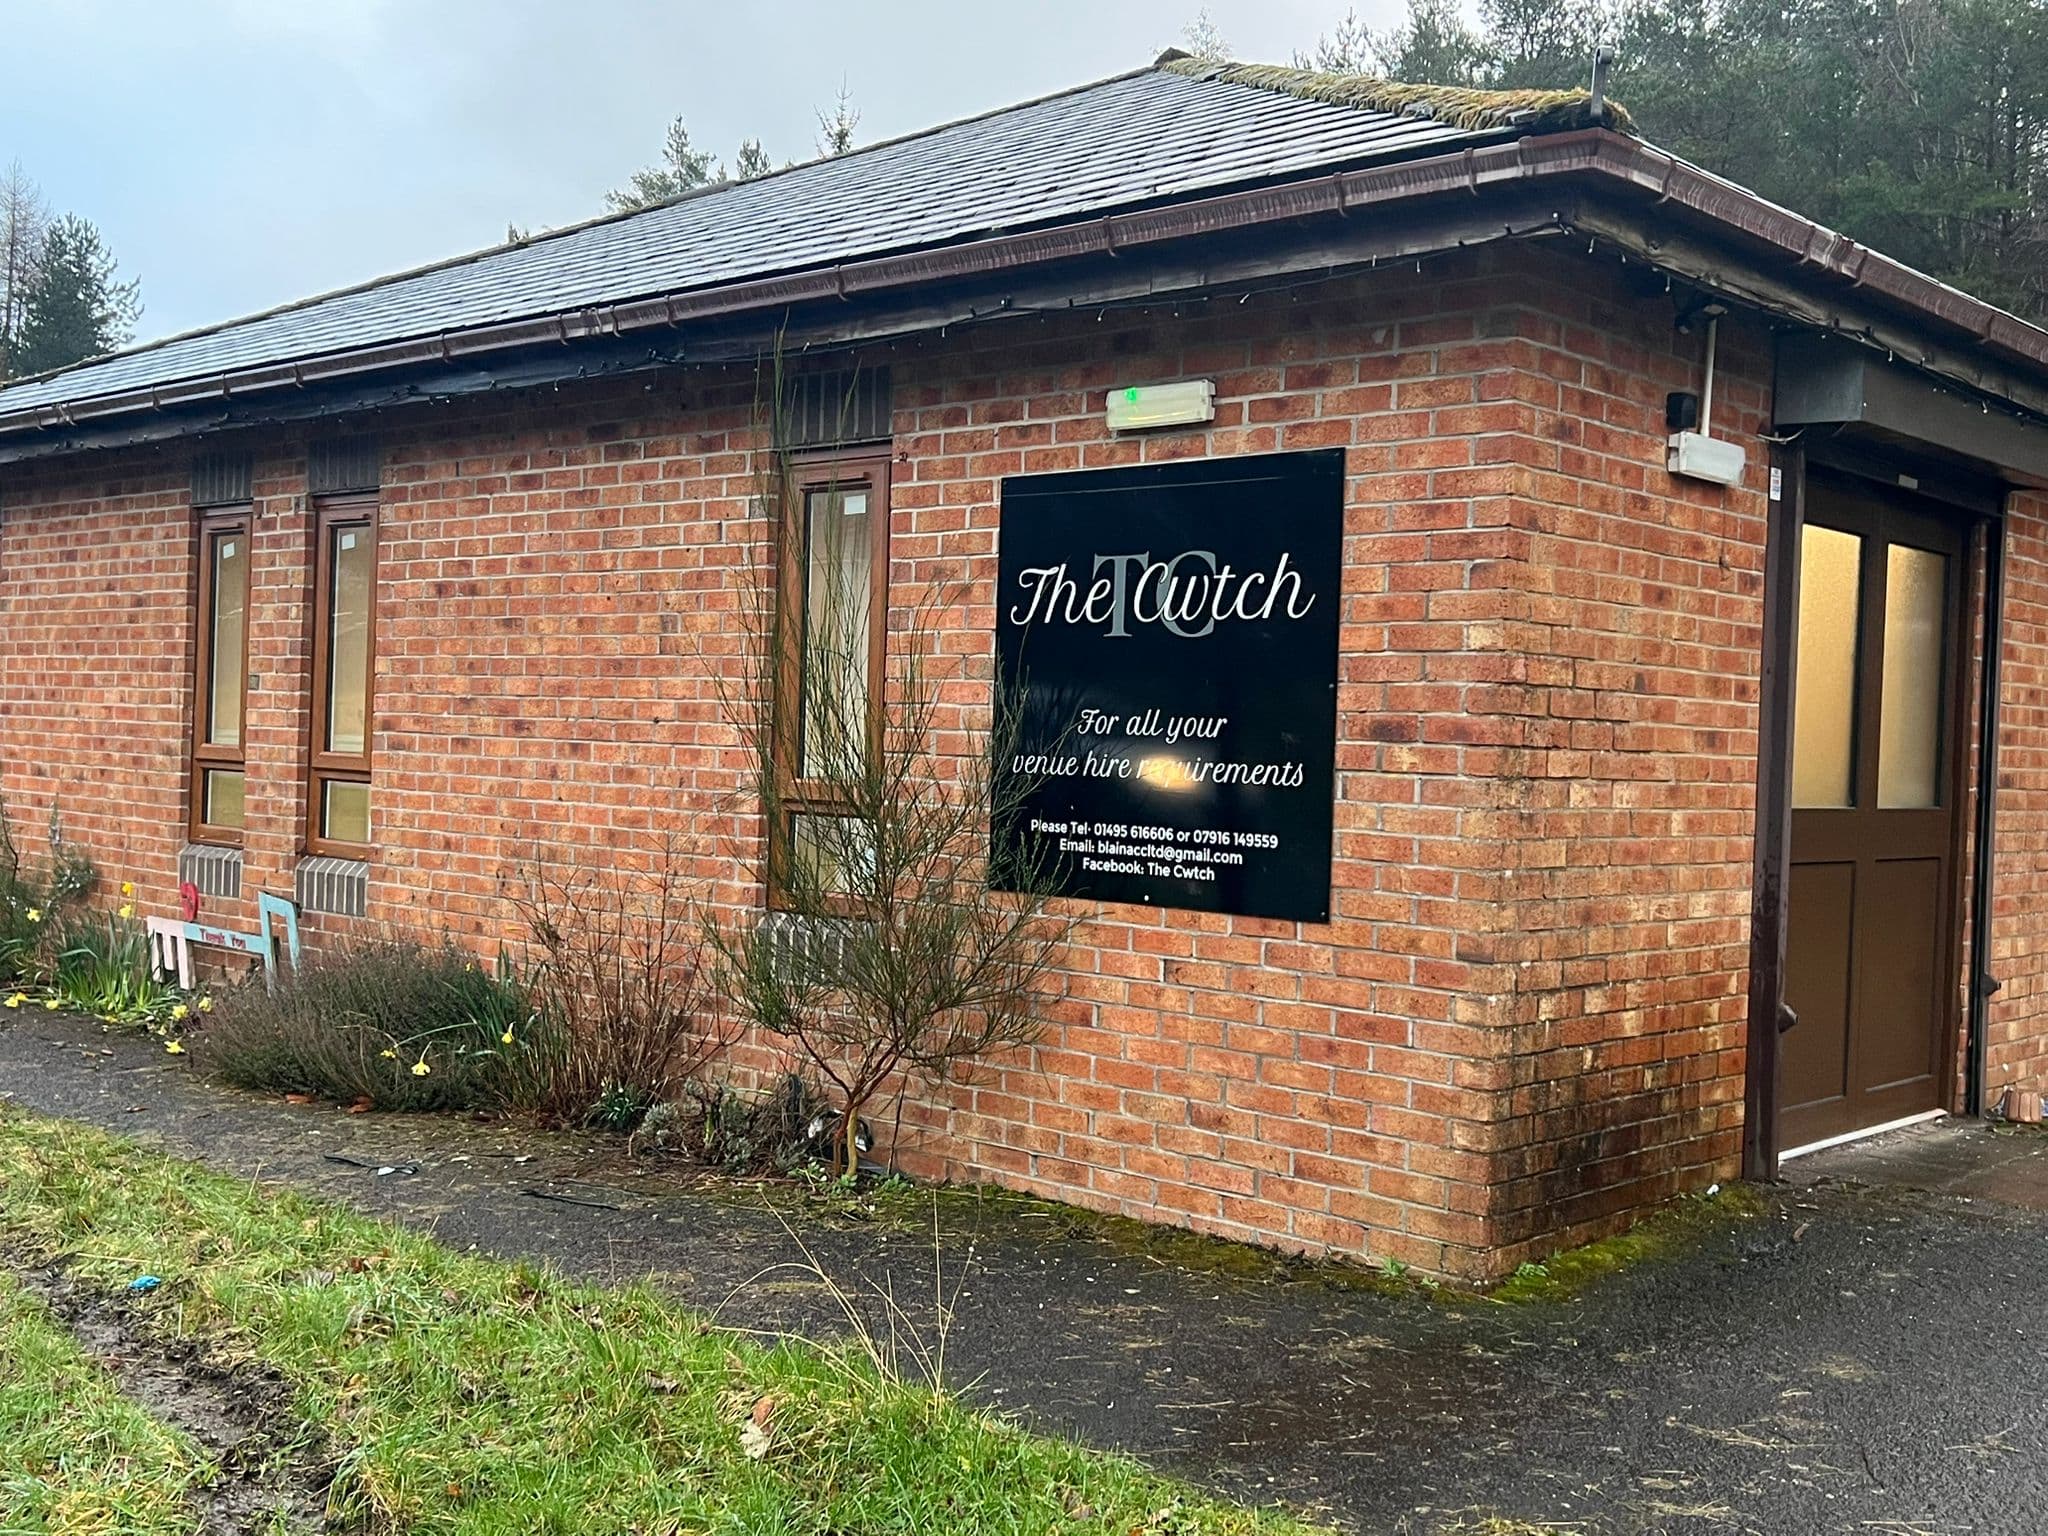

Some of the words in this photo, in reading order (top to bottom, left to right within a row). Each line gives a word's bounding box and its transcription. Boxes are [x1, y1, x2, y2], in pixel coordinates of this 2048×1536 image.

[1010, 563, 1116, 625] The
[1133, 552, 1316, 623] Cwtch
[1077, 709, 1119, 735] For
[1125, 709, 1163, 736] all
[1166, 716, 1227, 744] your
[1012, 753, 1079, 775] venue
[1083, 750, 1131, 779] hire
[1030, 819, 1068, 834] Please
[1094, 823, 1128, 837] 01495
[1130, 825, 1174, 840] 616606
[1176, 831, 1191, 842] or
[1193, 829, 1230, 845] 07916
[1233, 832, 1279, 848] 149559
[1059, 838, 1095, 853] Email:
[1097, 840, 1243, 865] blainaccltd@gmail.com
[1082, 857, 1145, 875] Facebook:
[1147, 862, 1171, 877] The
[1173, 864, 1215, 881] Cwtch
